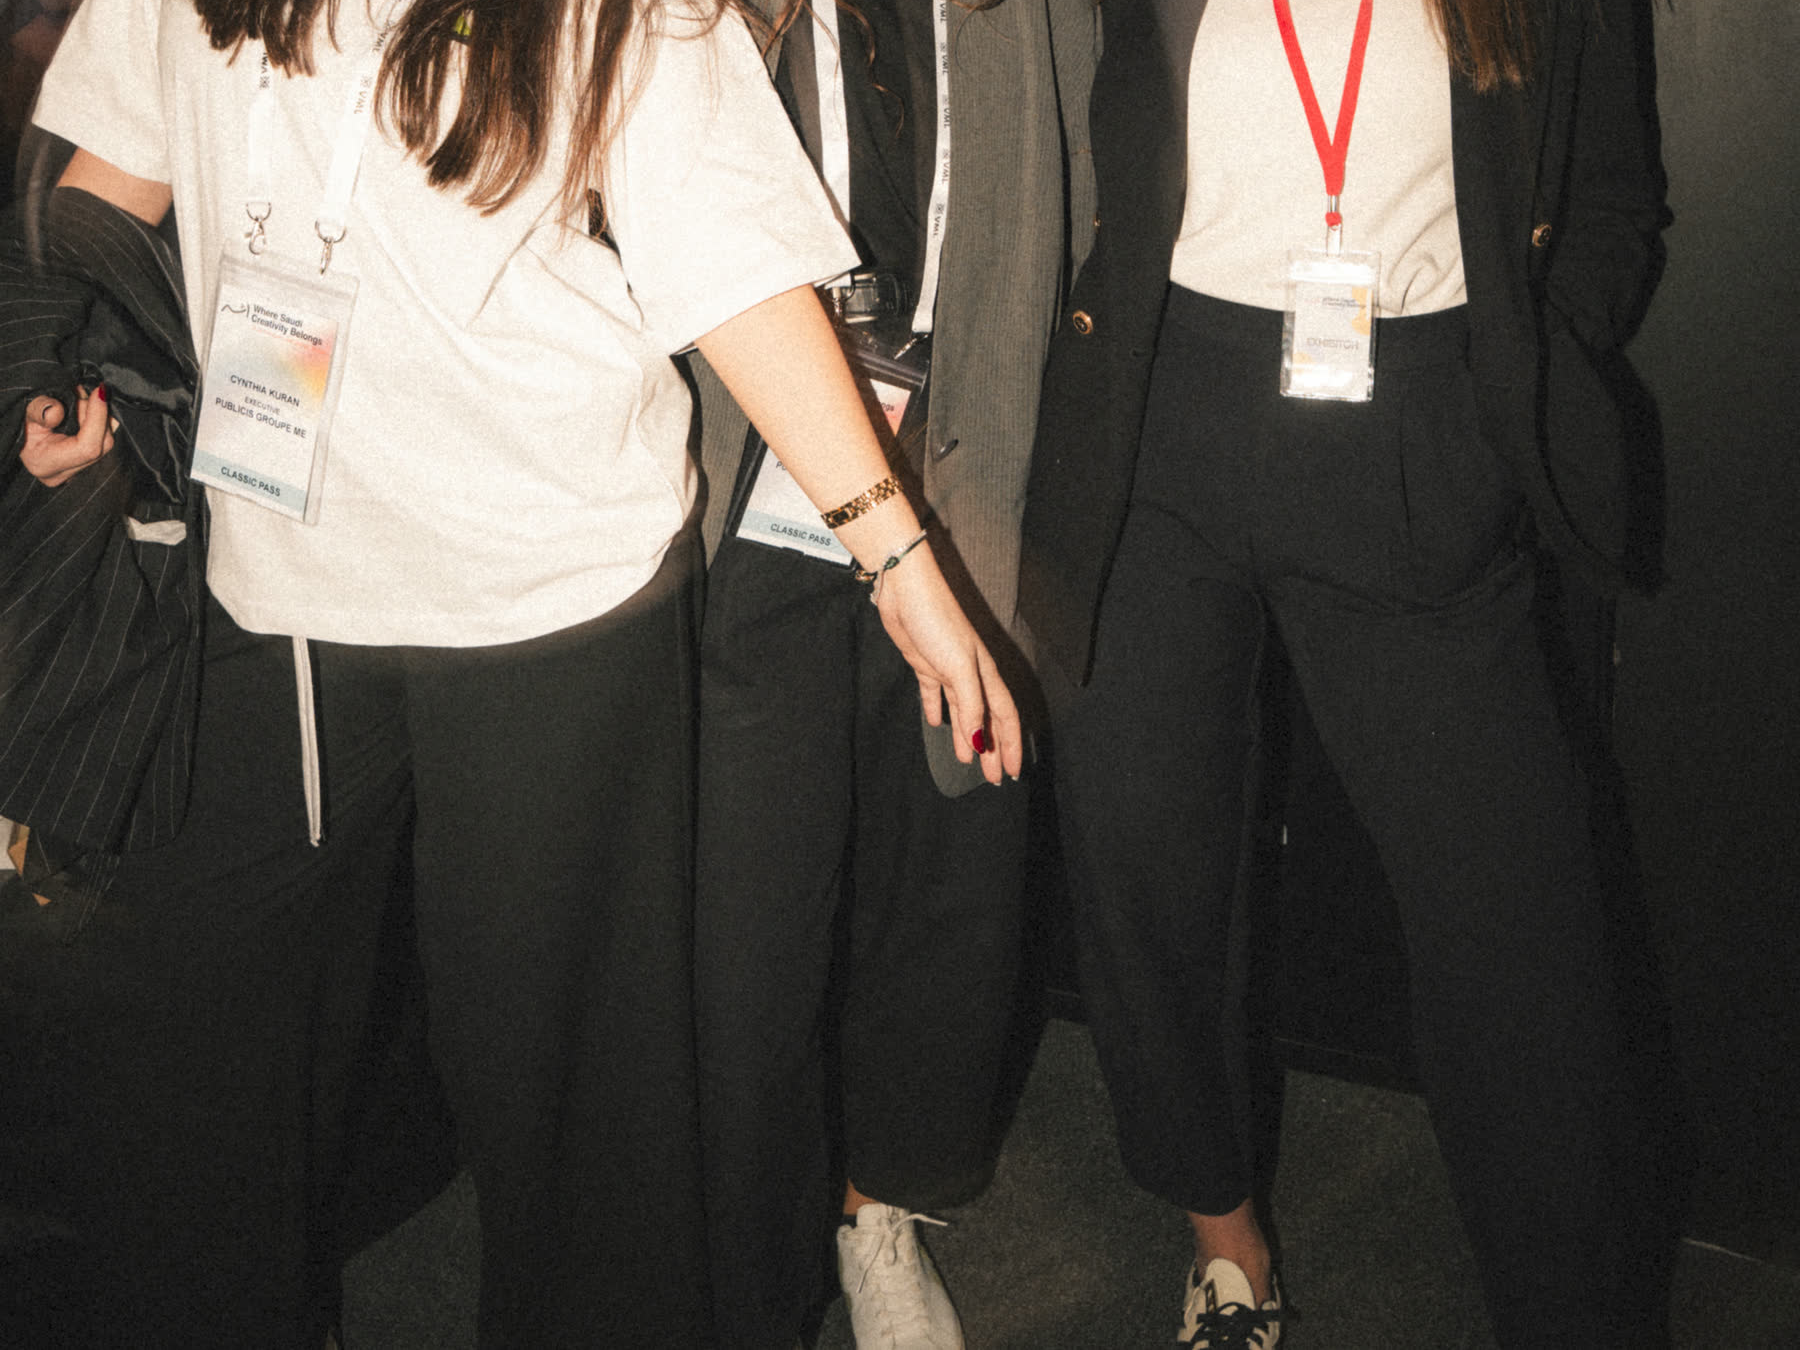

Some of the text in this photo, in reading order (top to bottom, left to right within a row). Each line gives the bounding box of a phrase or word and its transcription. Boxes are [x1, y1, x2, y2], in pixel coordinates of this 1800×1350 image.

[939, 2, 947, 23] VML
[373, 28, 388, 52] VML
[355, 90, 368, 115] VML
[932, 215, 941, 238] VML
[253, 304, 303, 327] Where Saudi
[251, 314, 323, 346] Creativity Belongs
[230, 374, 300, 407] CYNTHIA KURAN
[216, 397, 306, 438] PUBLICIS GROUPE ME
[244, 396, 280, 415] EXECUTIVE
[221, 466, 280, 497] CLASSIC PASS
[770, 523, 832, 546] CLASSIC PASS
